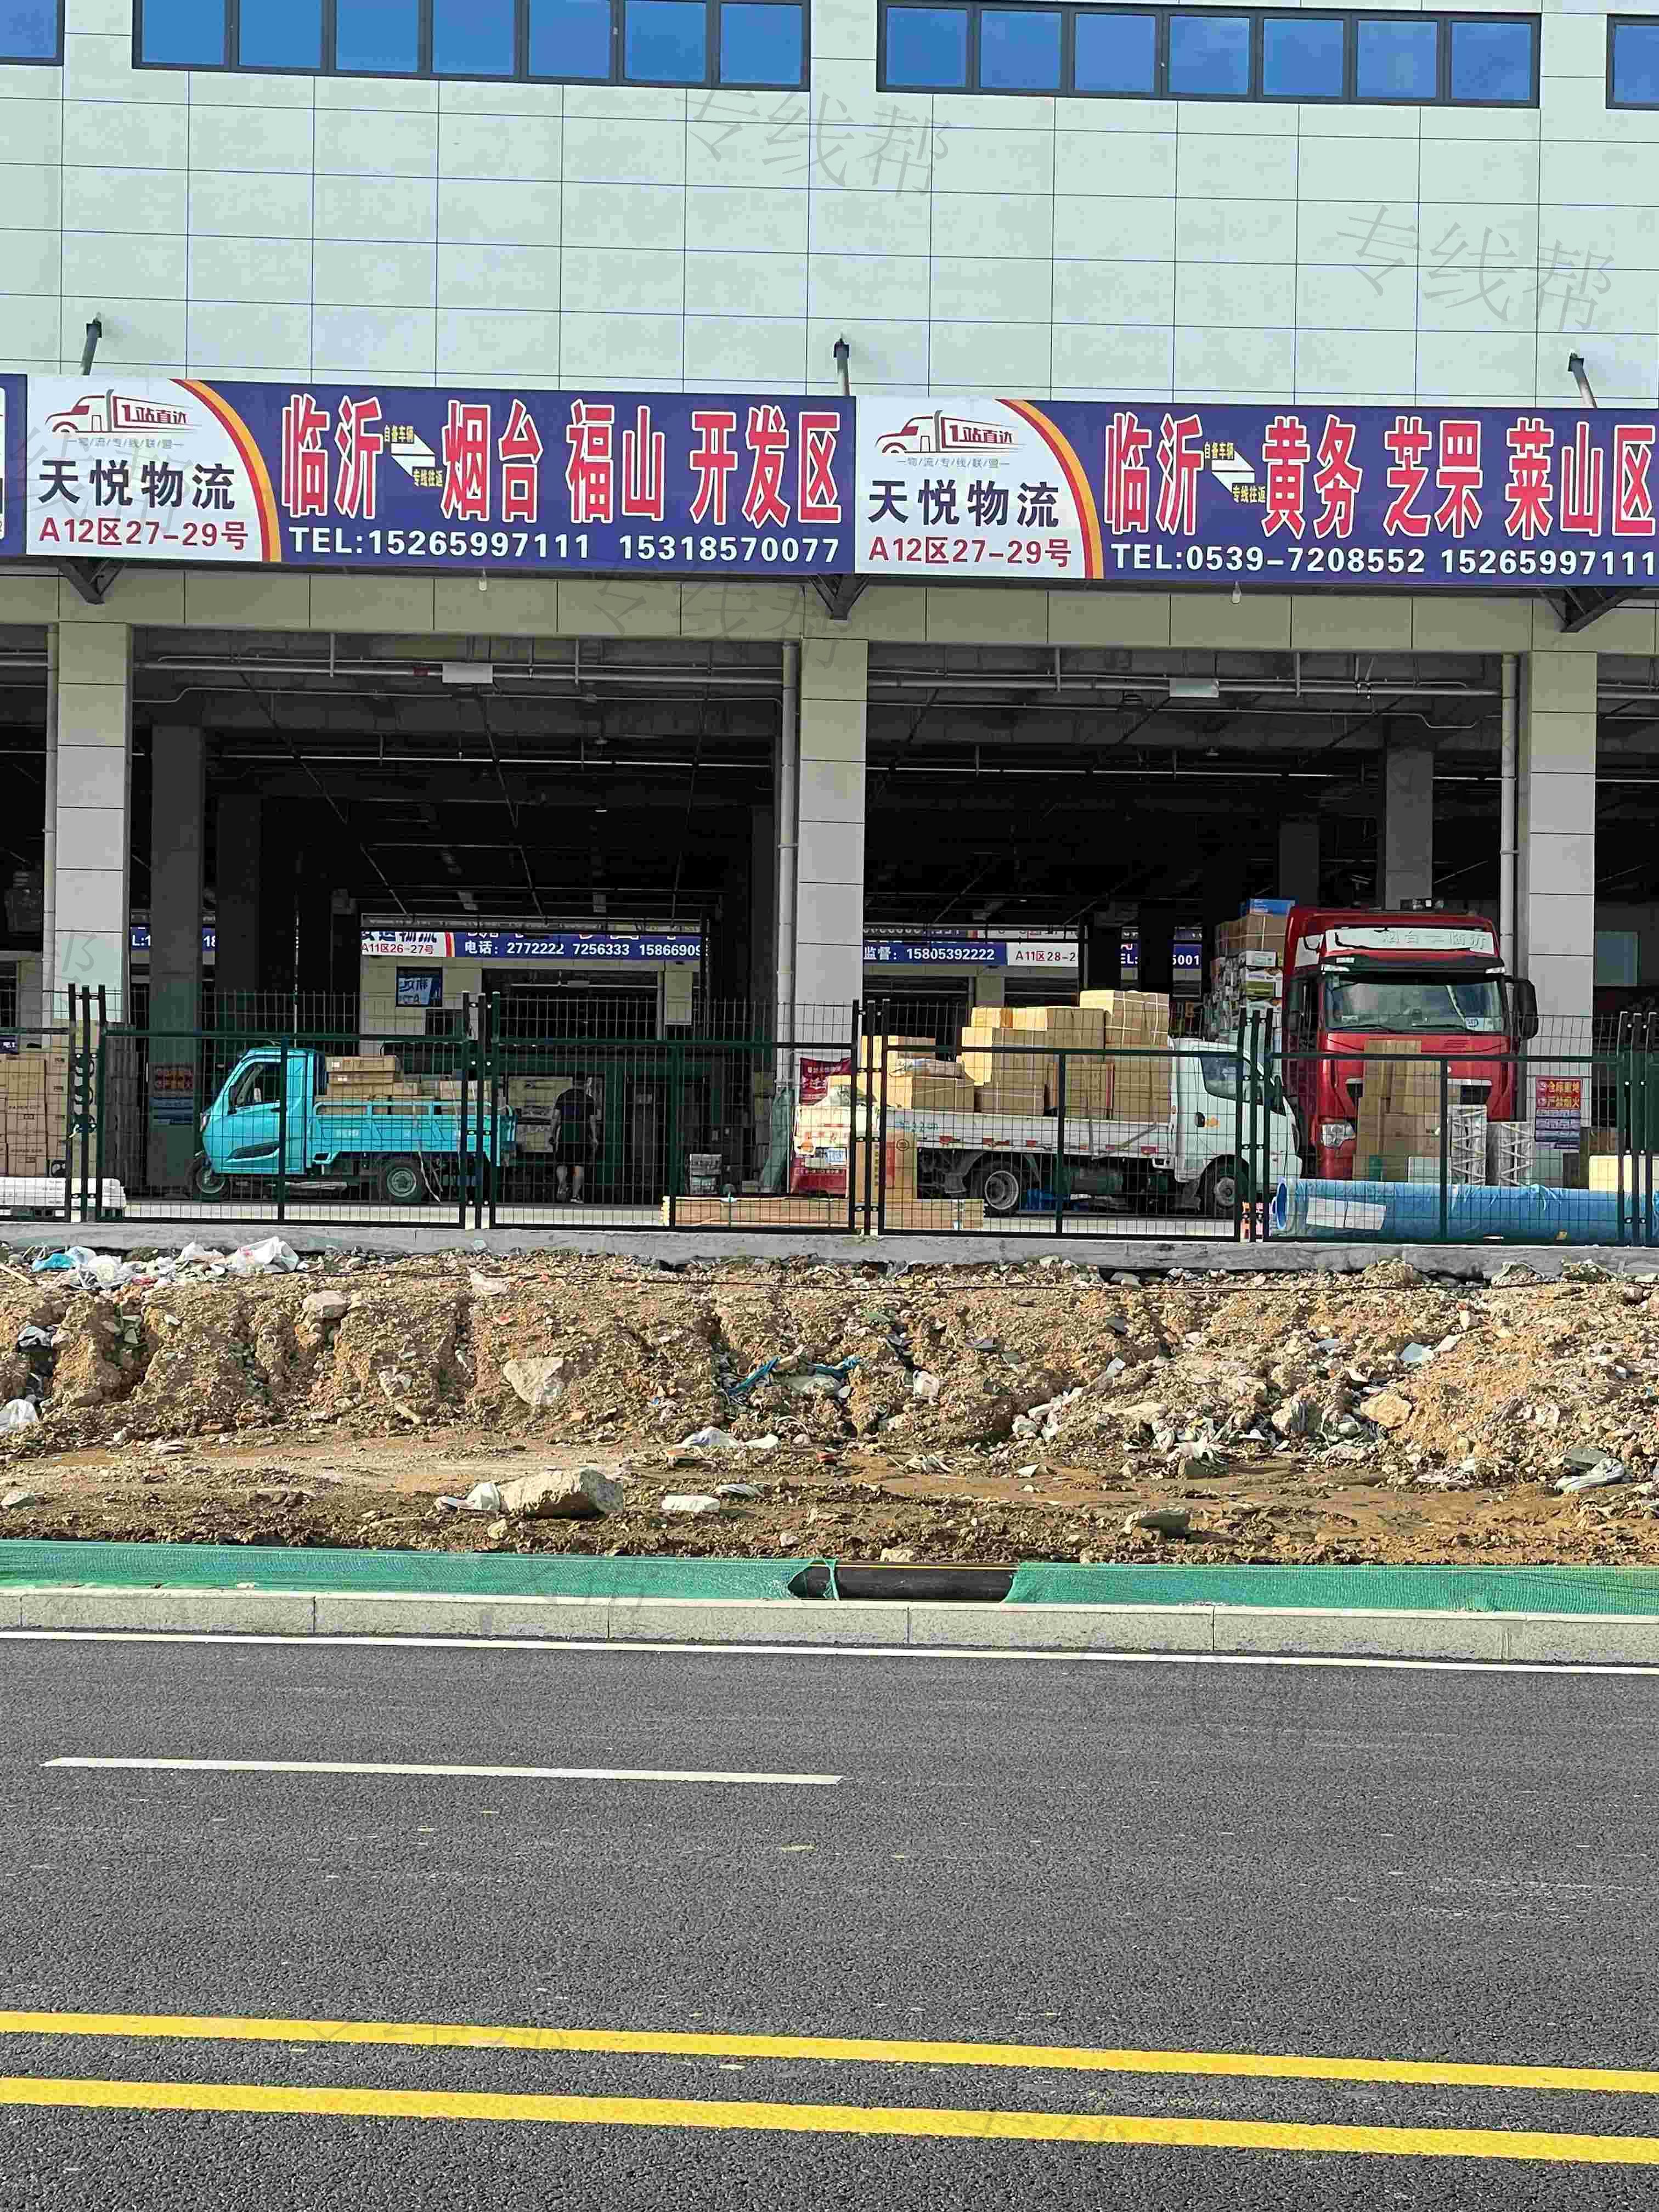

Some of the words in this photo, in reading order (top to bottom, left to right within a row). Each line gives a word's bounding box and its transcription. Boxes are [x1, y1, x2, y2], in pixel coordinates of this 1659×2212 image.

[281, 393, 382, 519] 临沂
[440, 399, 543, 522] 烟台
[566, 399, 664, 523] 福山
[690, 405, 841, 528] 开发区
[1104, 411, 1203, 536] 临沂
[1262, 414, 1362, 540] 黄务
[1383, 416, 1483, 539] 芝罘
[1505, 417, 1656, 540] 莱山区
[38, 459, 236, 510] 天悦物流
[868, 479, 1059, 527] 天悦物流
[38, 517, 249, 550] A12区27-29号
[289, 526, 589, 558] TEL:15265997111
[619, 535, 839, 563] 15318570077
[869, 537, 1071, 568] A12区27-29号
[1111, 543, 1425, 574] TEL:0539-7208552
[1441, 549, 1656, 576] 15265997111
[573, 943, 630, 956] 7256333
[906, 947, 995, 961] 15805392222
